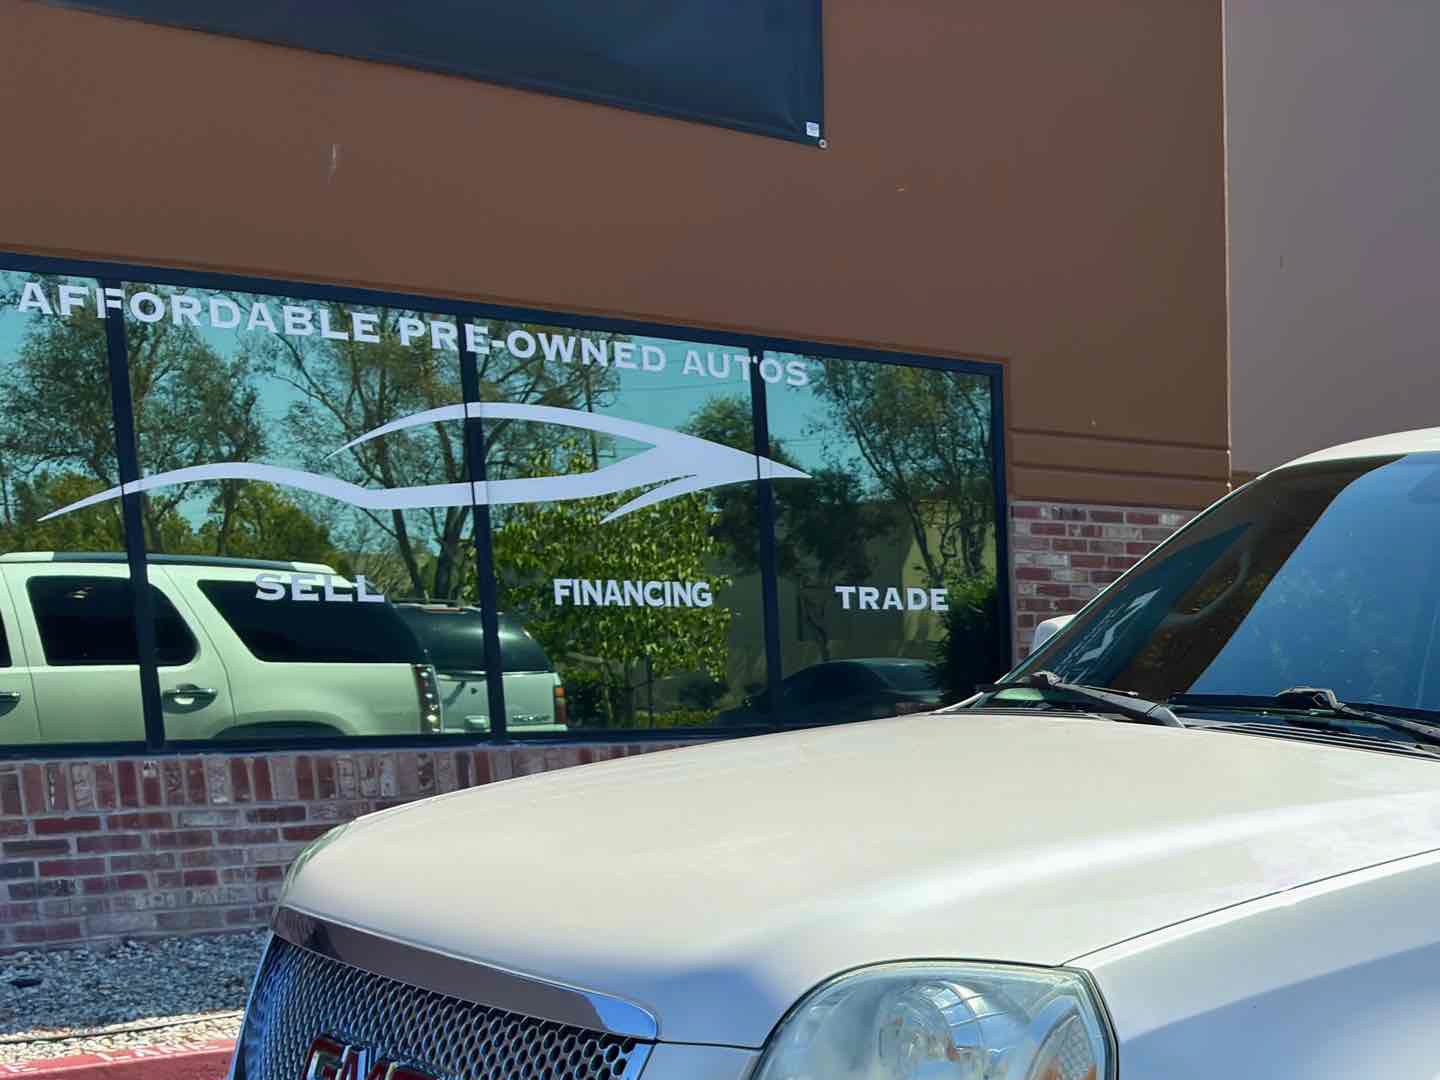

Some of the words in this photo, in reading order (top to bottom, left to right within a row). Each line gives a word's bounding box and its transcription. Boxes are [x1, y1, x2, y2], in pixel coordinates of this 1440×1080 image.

[18, 281, 381, 344] AFFORDABLE
[400, 314, 667, 373] PRE-OWNED
[681, 349, 810, 387] AUTOS
[255, 573, 386, 603] SELL
[553, 579, 713, 608] FINANCING
[834, 585, 950, 612] TRADE
